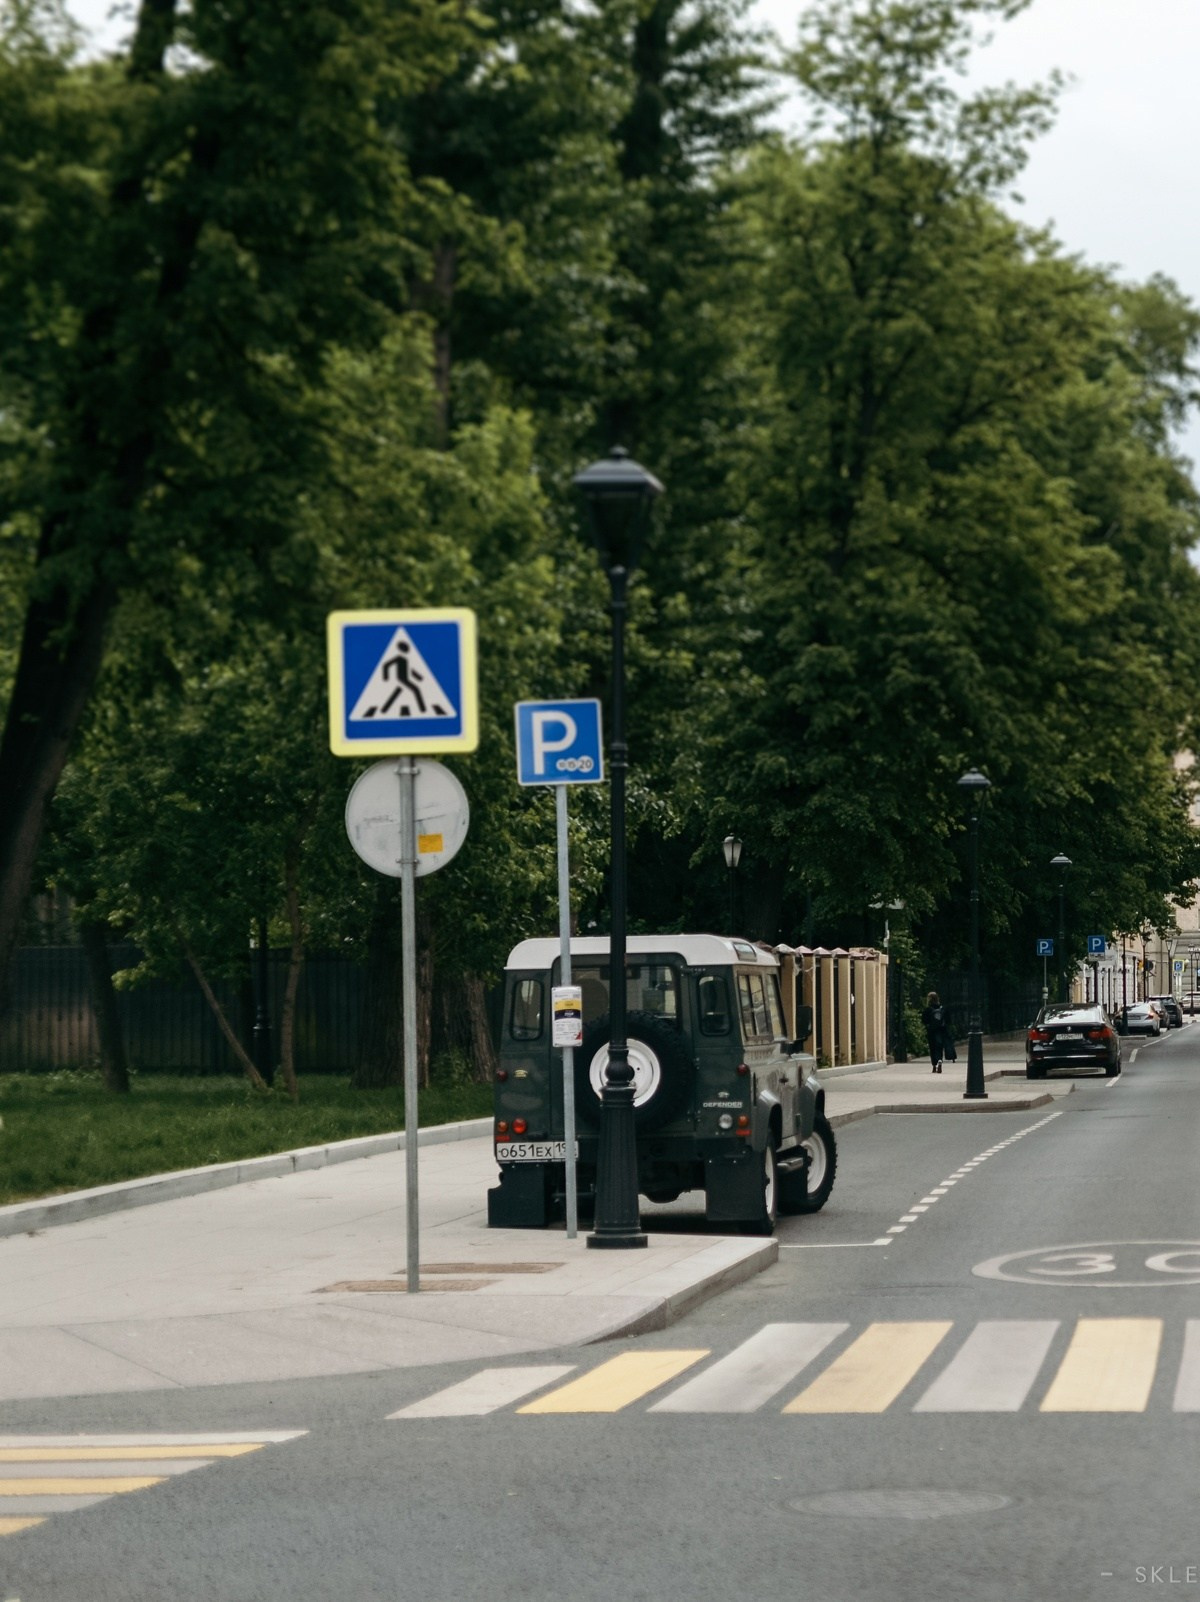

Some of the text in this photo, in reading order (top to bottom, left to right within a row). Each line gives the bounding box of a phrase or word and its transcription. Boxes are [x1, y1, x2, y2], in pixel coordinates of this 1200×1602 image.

[532, 710, 577, 775] P
[579, 759, 592, 769] 20
[1039, 941, 1049, 954] P
[1092, 938, 1101, 951] P
[703, 1101, 743, 1109] DEFENDER
